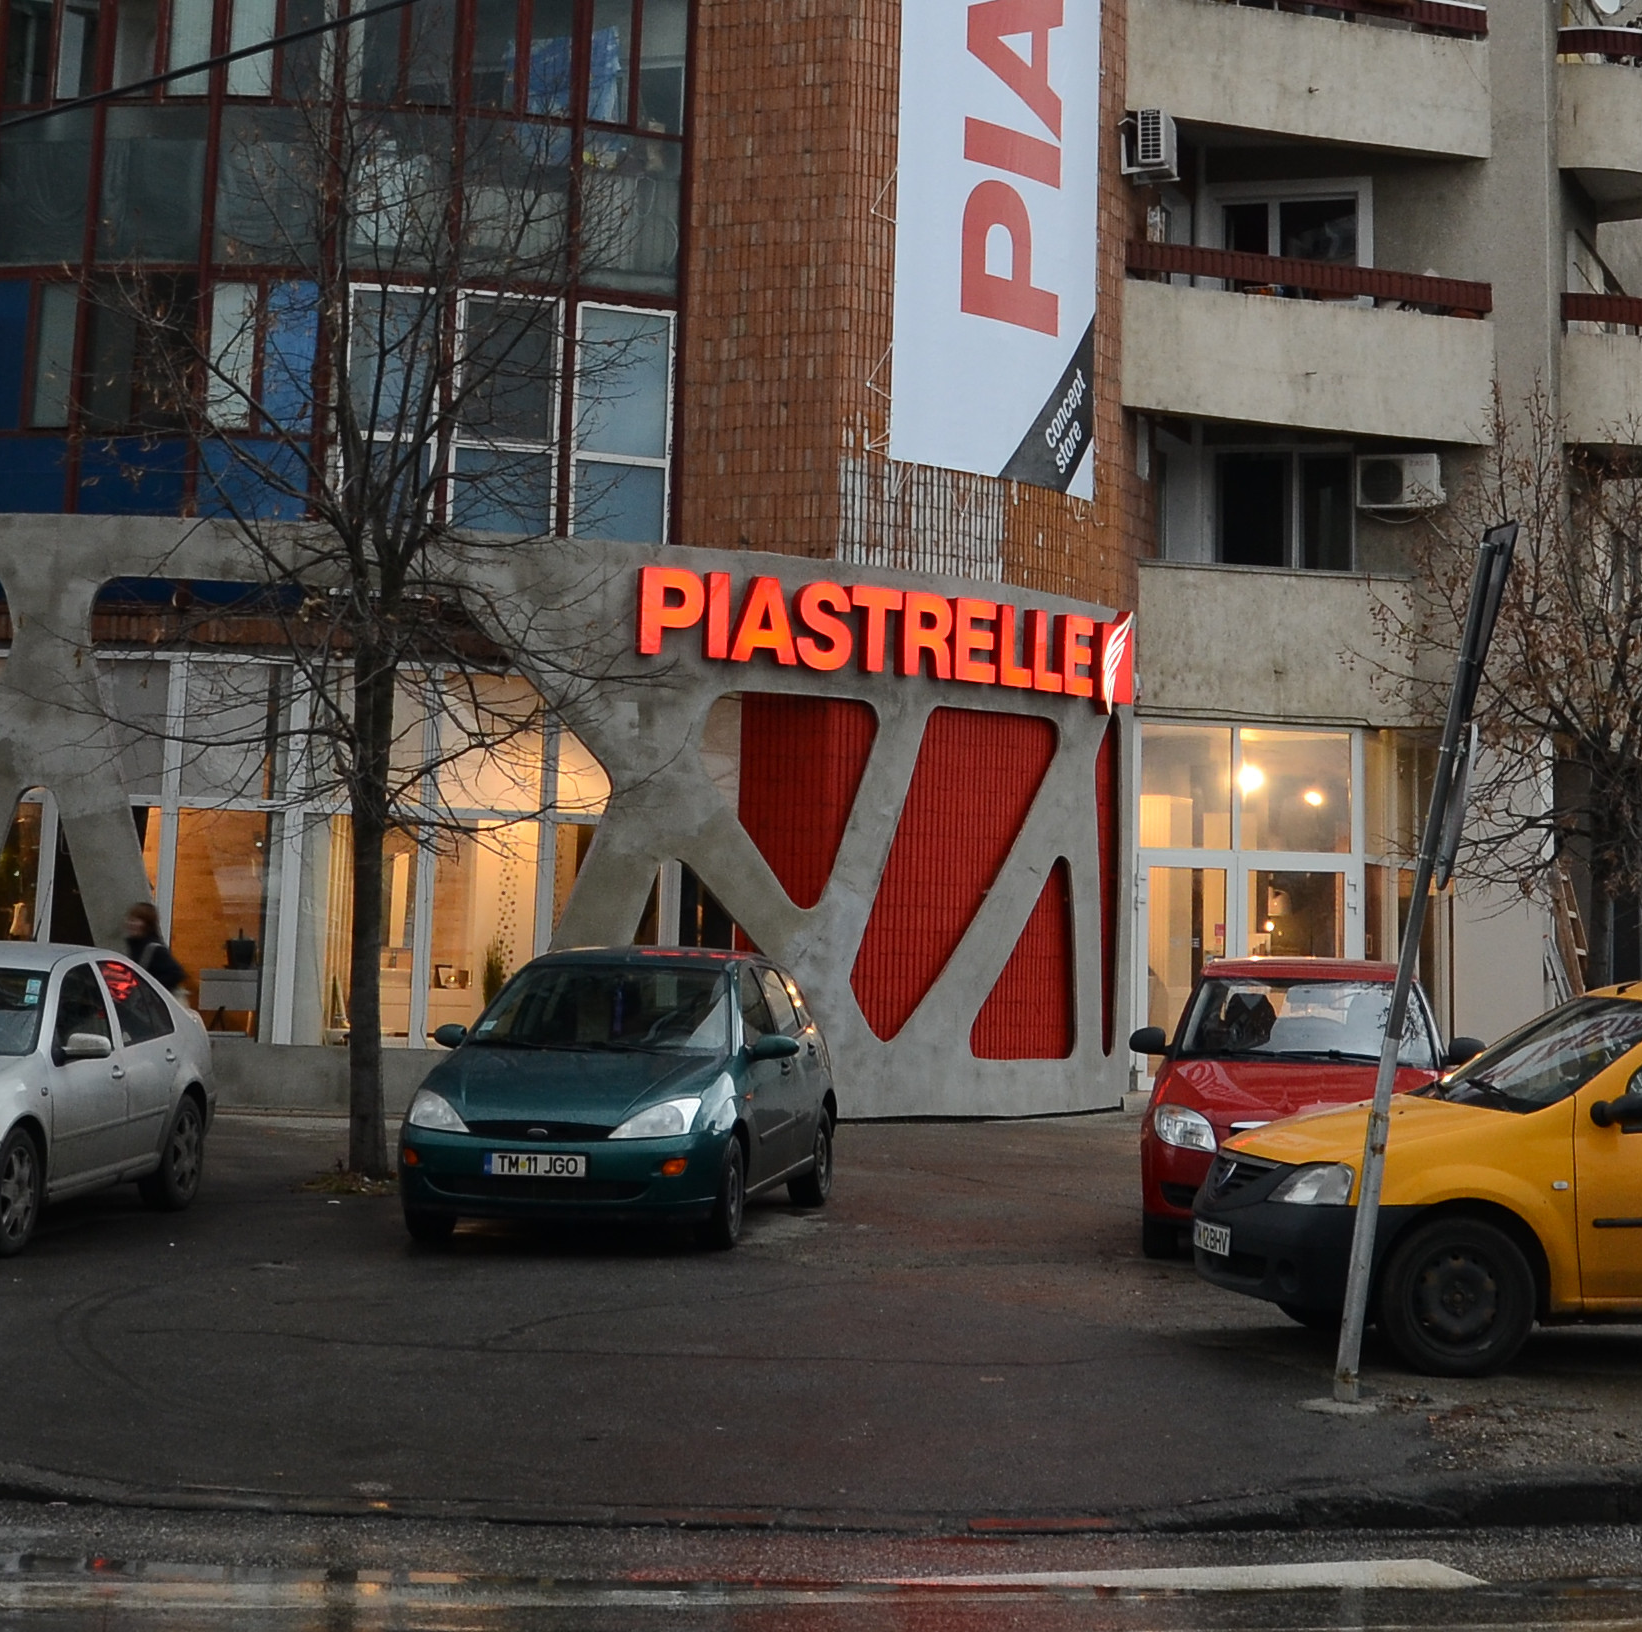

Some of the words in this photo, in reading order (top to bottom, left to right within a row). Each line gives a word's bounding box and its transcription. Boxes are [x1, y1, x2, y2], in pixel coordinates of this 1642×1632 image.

[1045, 368, 1086, 449] concept
[1056, 421, 1082, 474] store
[636, 566, 1094, 698] PIASTRELLE
[498, 1154, 520, 1173] TM
[525, 1156, 538, 1174] 11
[543, 1156, 578, 1176] JGO
[1209, 1227, 1229, 1254] BHV
